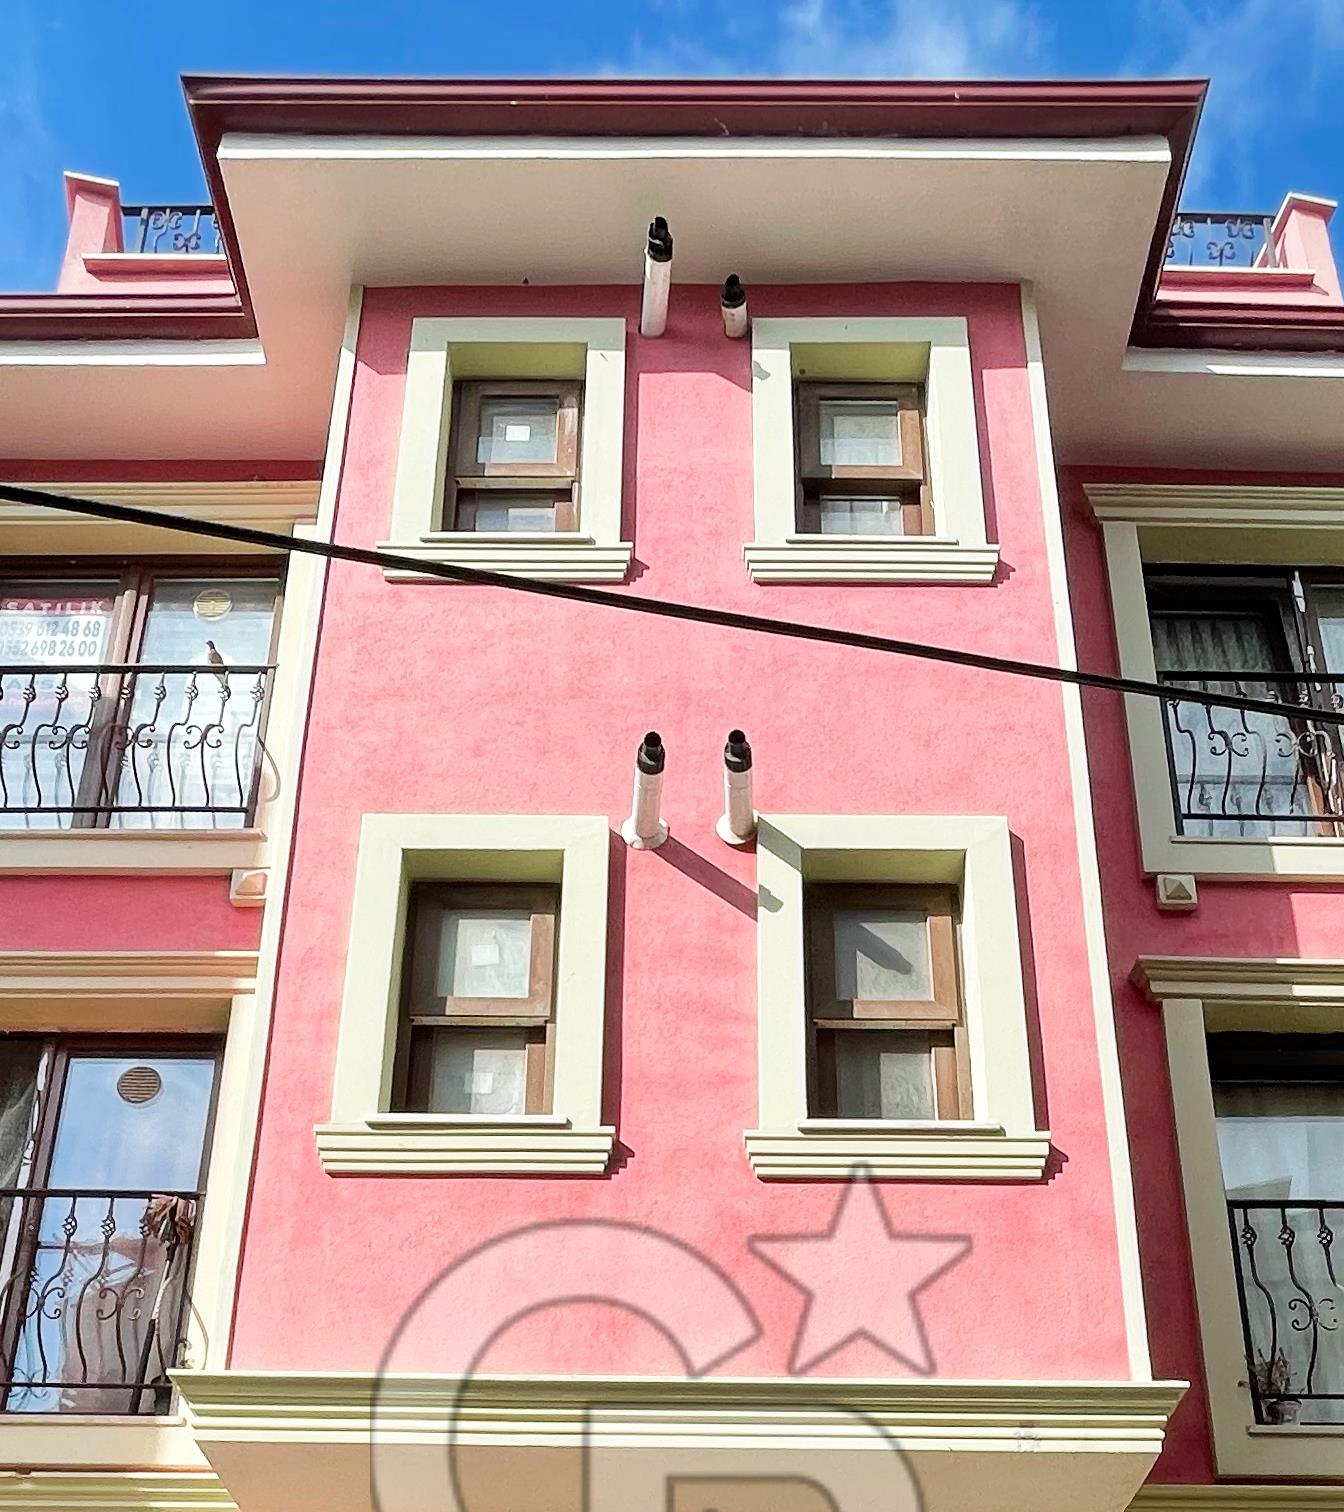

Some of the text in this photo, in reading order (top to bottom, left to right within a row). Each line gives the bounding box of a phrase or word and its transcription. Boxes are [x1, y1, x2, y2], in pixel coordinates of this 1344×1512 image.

[5, 600, 105, 615] SATILIK
[61, 620, 80, 637] 48
[83, 620, 102, 638] 68
[31, 640, 57, 657] 698
[59, 640, 75, 657] 26
[78, 640, 98, 657] 00
